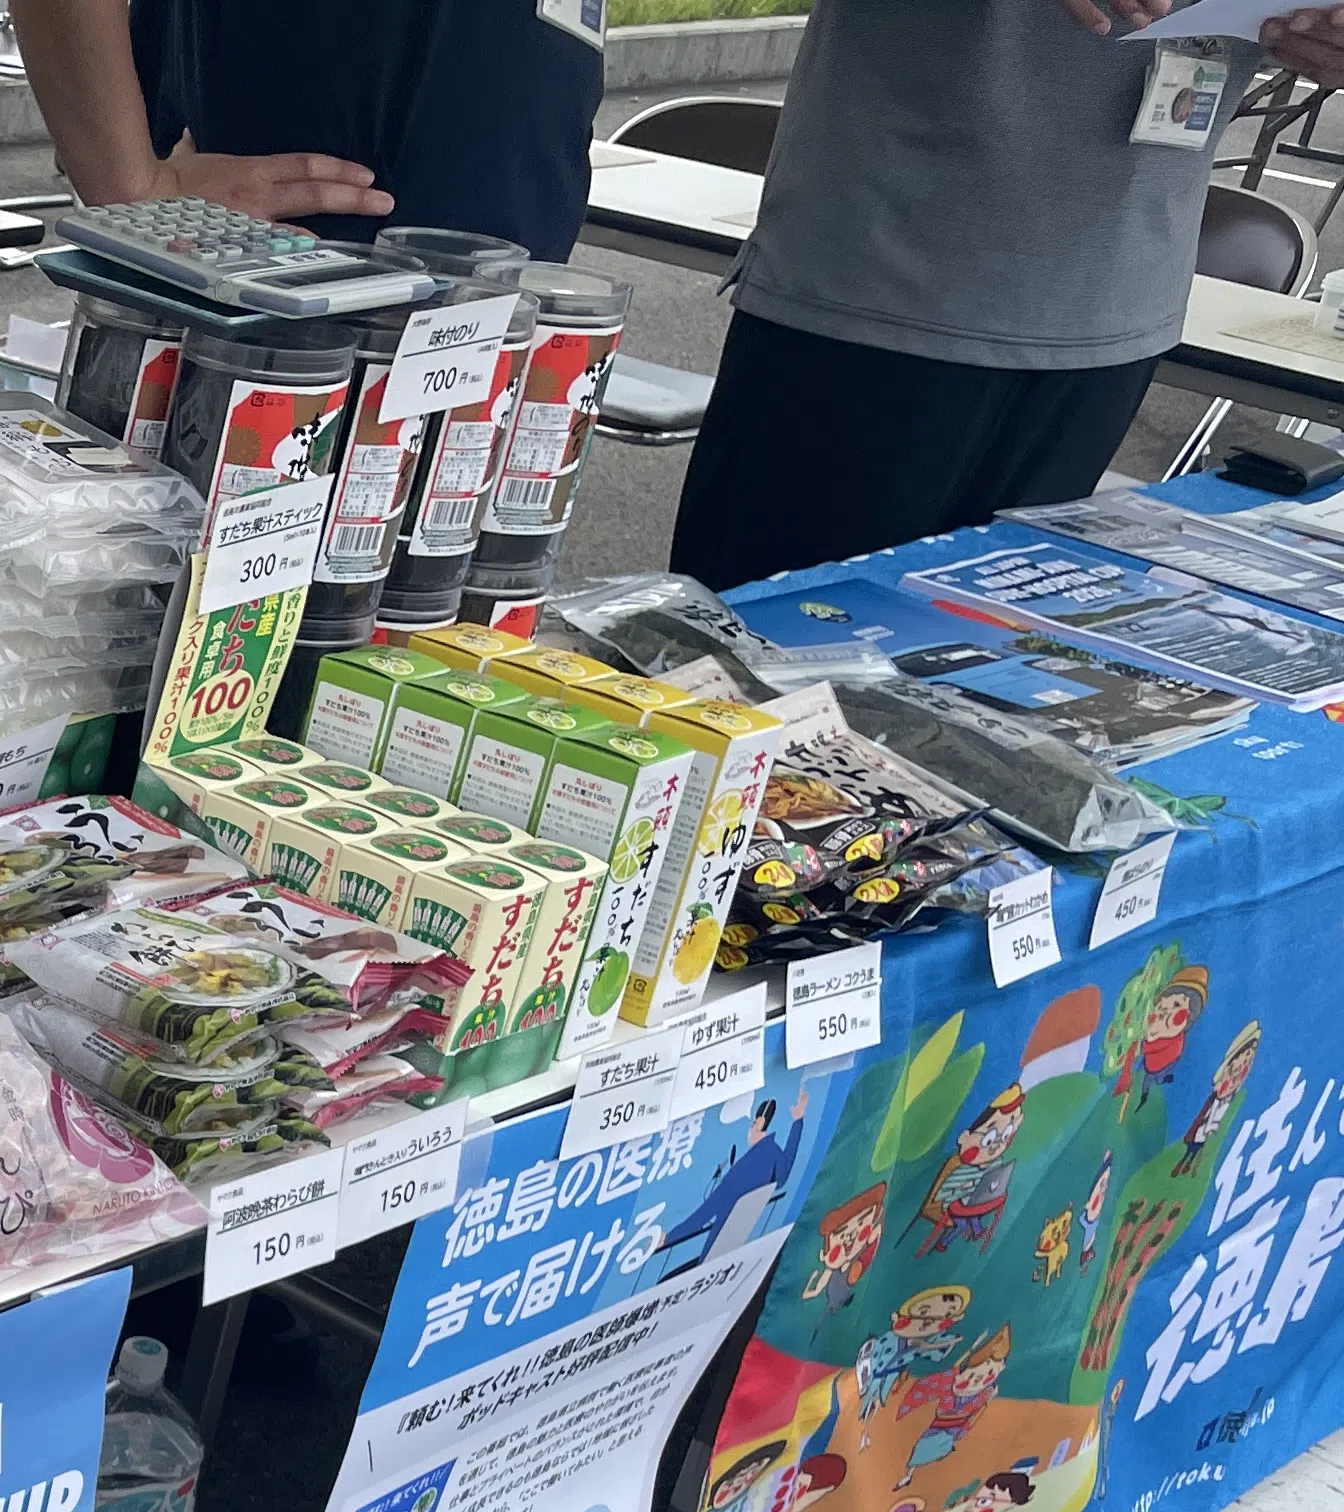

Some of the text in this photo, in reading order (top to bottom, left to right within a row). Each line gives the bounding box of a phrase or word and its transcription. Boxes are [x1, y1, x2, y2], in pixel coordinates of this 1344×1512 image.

[428, 321, 479, 347] 味付のり
[423, 367, 458, 395] 700
[219, 502, 323, 541] すだち果汁スティック
[240, 553, 289, 584] 300 円
[192, 676, 252, 719] 100
[1114, 896, 1138, 922] 450
[542, 876, 594, 991] すだち
[1012, 934, 1035, 961] 550
[480, 893, 533, 1009] すだち
[793, 966, 876, 1000] 徳島ラーメン コクうま
[691, 1013, 740, 1046] ゆず果汁
[817, 1013, 849, 1041] 550
[600, 1054, 661, 1088] すだち果汁
[694, 1060, 729, 1092] 450
[598, 1100, 636, 1131] 350
[92, 1194, 143, 1218] NARUTO
[222, 1178, 326, 1230] 阿波晩茶わらび餅
[381, 1180, 429, 1212] 150 円
[442, 1114, 703, 1270] 徳島の医療
[253, 1231, 305, 1265] 150 円
[407, 1201, 669, 1369] 声で届ける
